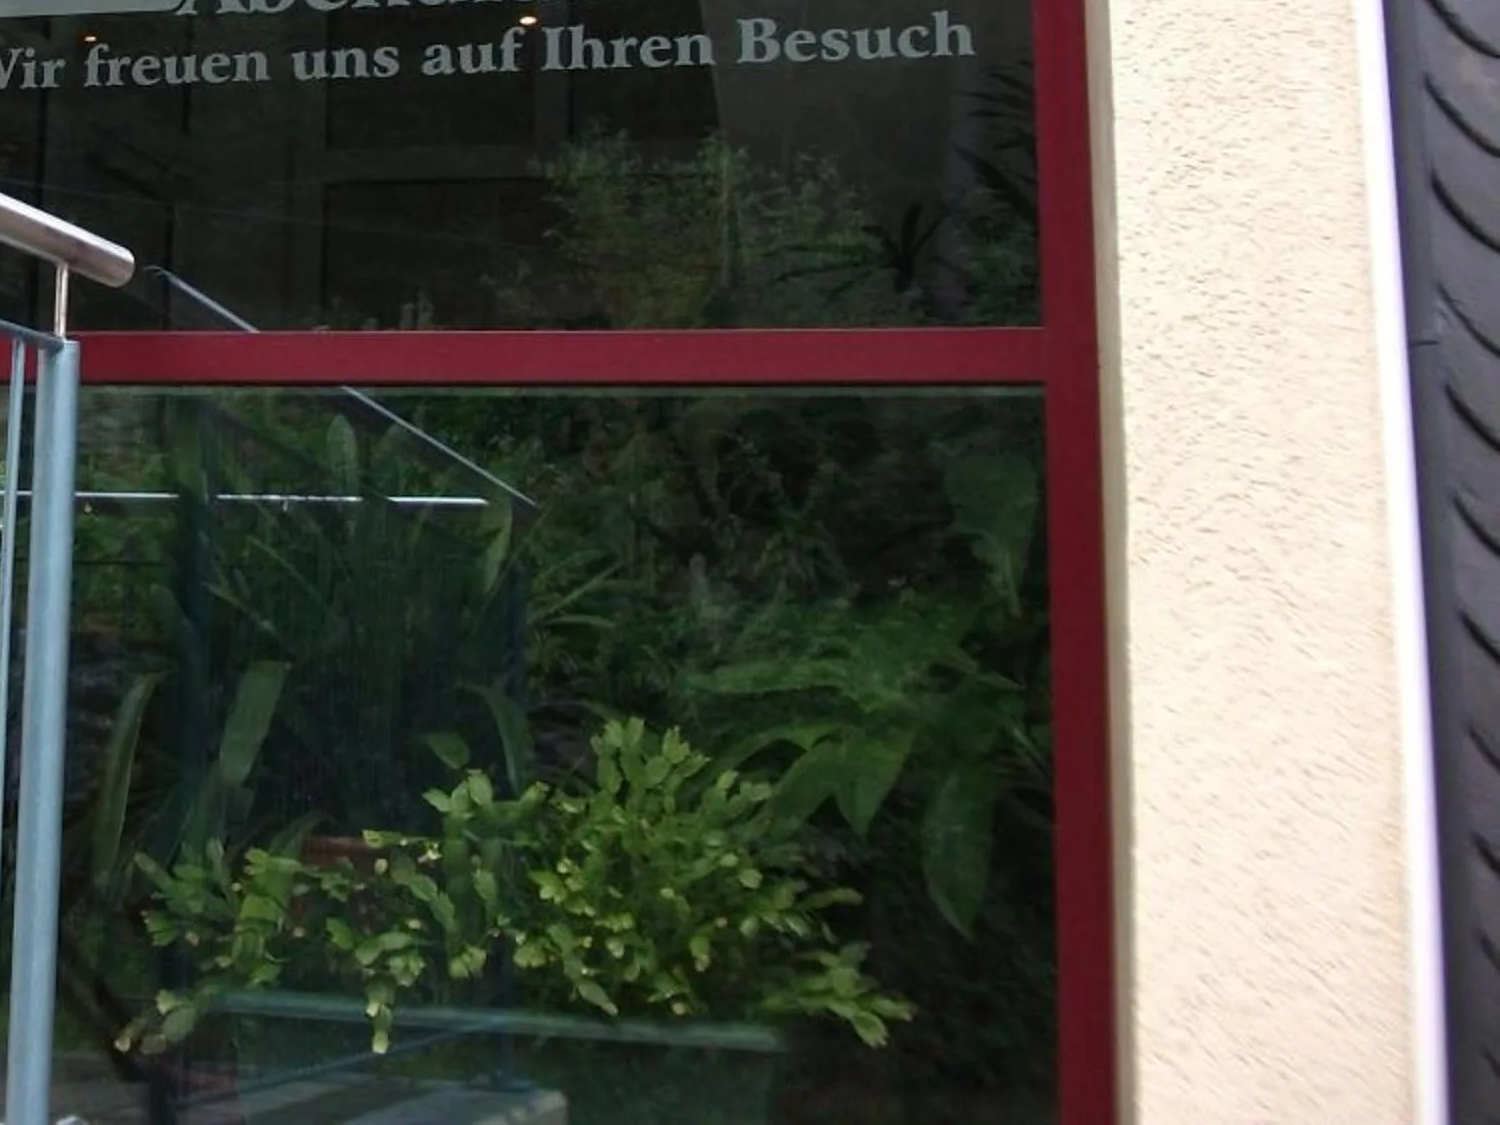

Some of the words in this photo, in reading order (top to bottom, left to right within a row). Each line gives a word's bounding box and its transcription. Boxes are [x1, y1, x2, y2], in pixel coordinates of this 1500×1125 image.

[83, 43, 271, 88] freuen
[291, 42, 401, 78] uns
[422, 26, 526, 75] auf
[541, 24, 716, 71] Ihren
[735, 10, 977, 65] Besuch
